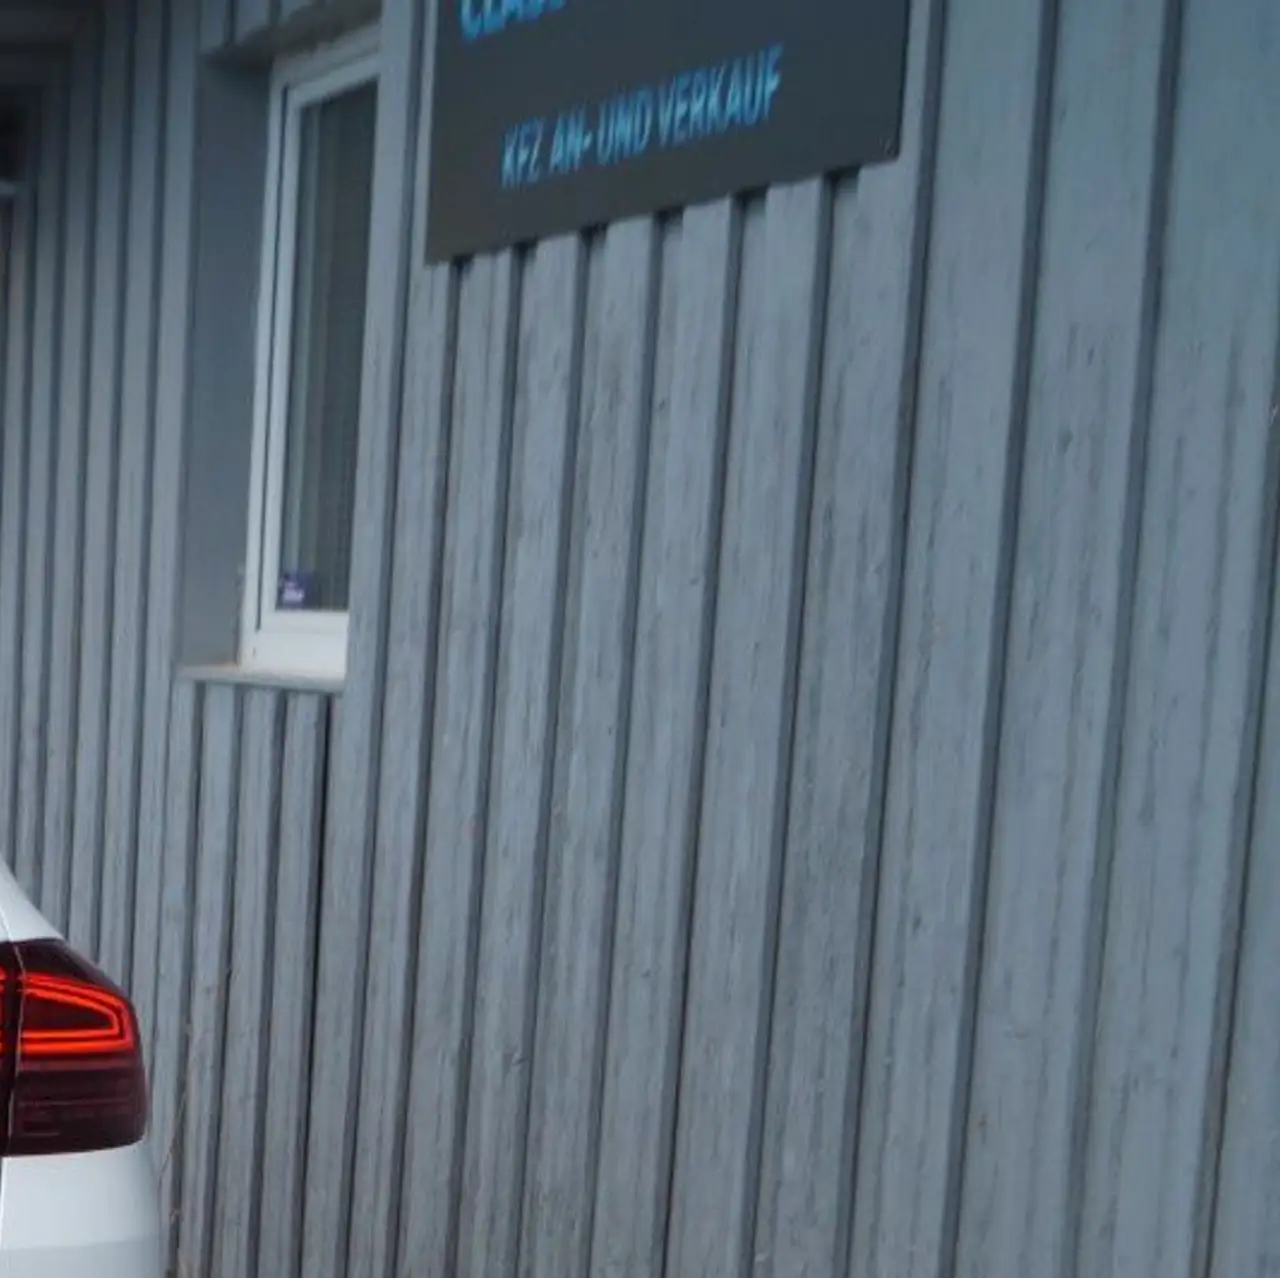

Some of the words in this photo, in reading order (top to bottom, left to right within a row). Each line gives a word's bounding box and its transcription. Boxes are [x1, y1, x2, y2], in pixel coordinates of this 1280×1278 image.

[501, 115, 544, 190] KFZ
[596, 84, 653, 168] UND
[657, 43, 784, 149] VERKAUF
